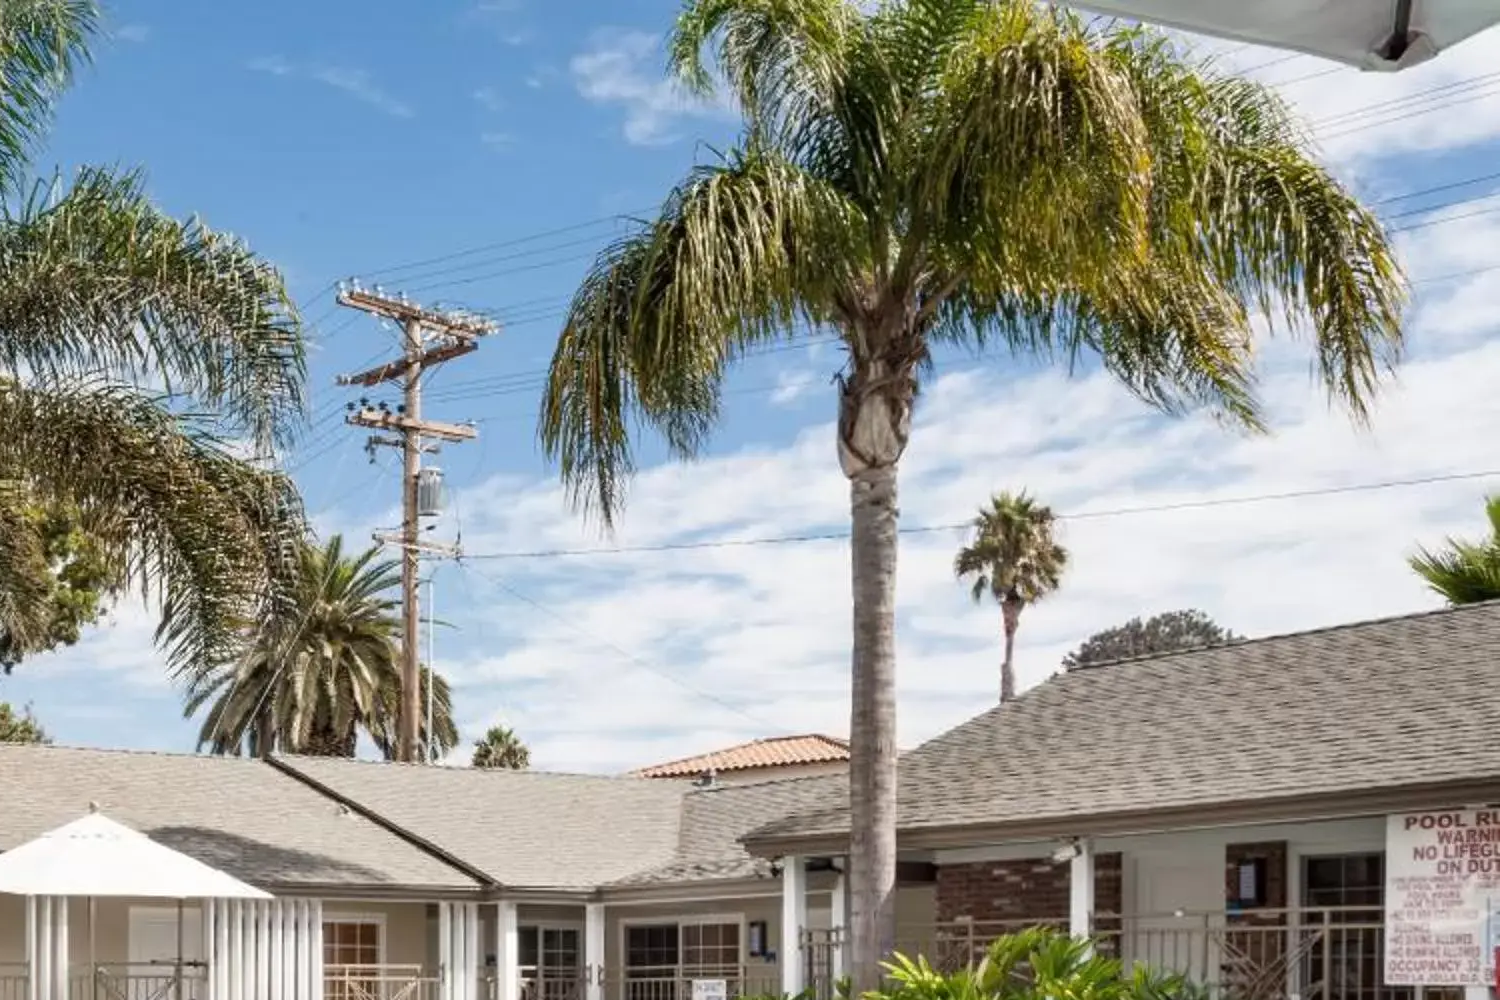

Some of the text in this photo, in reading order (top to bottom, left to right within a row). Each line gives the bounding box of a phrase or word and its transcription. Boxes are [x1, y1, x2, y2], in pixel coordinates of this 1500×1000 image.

[1405, 814, 1467, 830] POOL
[1437, 828, 1500, 844] WARNI
[1413, 846, 1438, 861] NO
[1437, 860, 1461, 874] ON
[1388, 960, 1461, 972] OCCUPANCY
